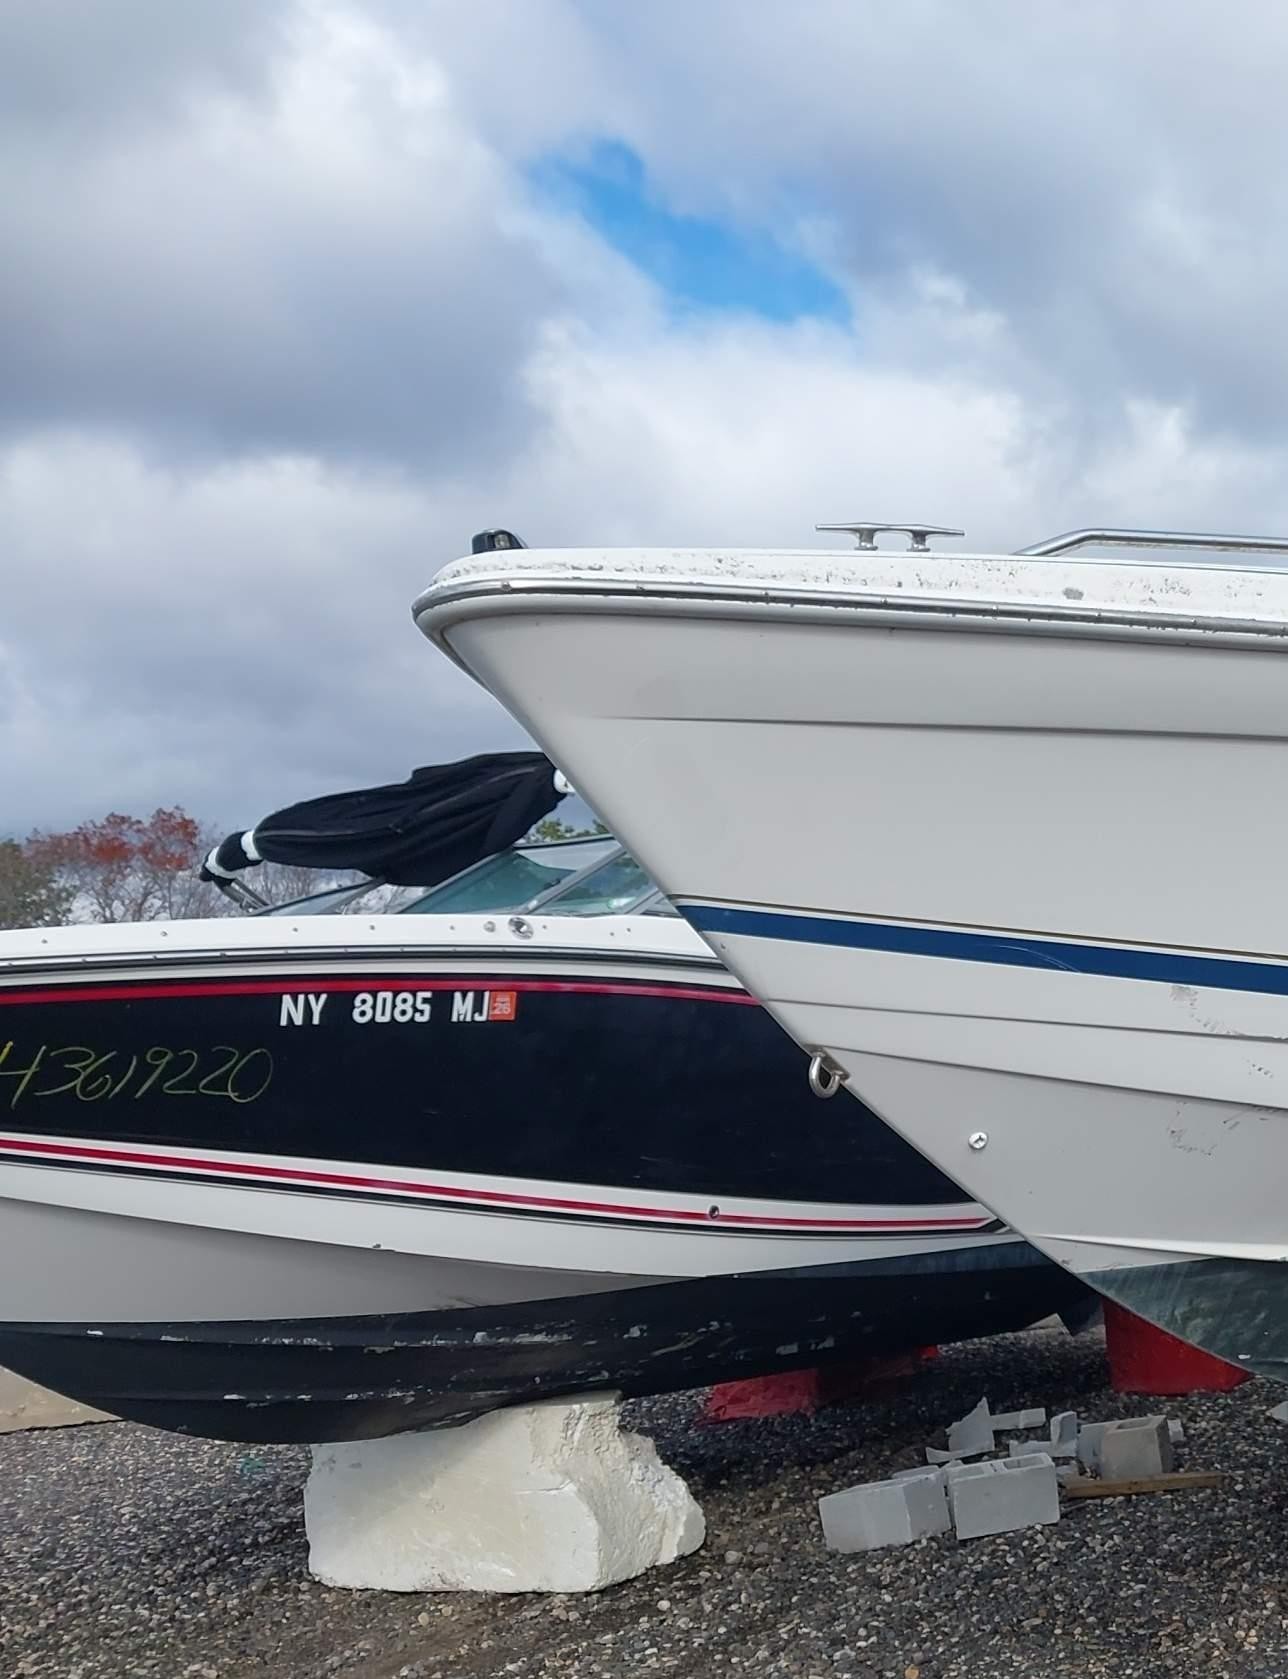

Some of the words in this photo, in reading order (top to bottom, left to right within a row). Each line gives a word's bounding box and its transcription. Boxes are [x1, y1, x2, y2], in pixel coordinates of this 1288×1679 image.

[279, 993, 329, 1027] NY
[351, 991, 433, 1024] 8085
[450, 990, 491, 1023] MJ
[0, 1040, 275, 1110] 43619220
